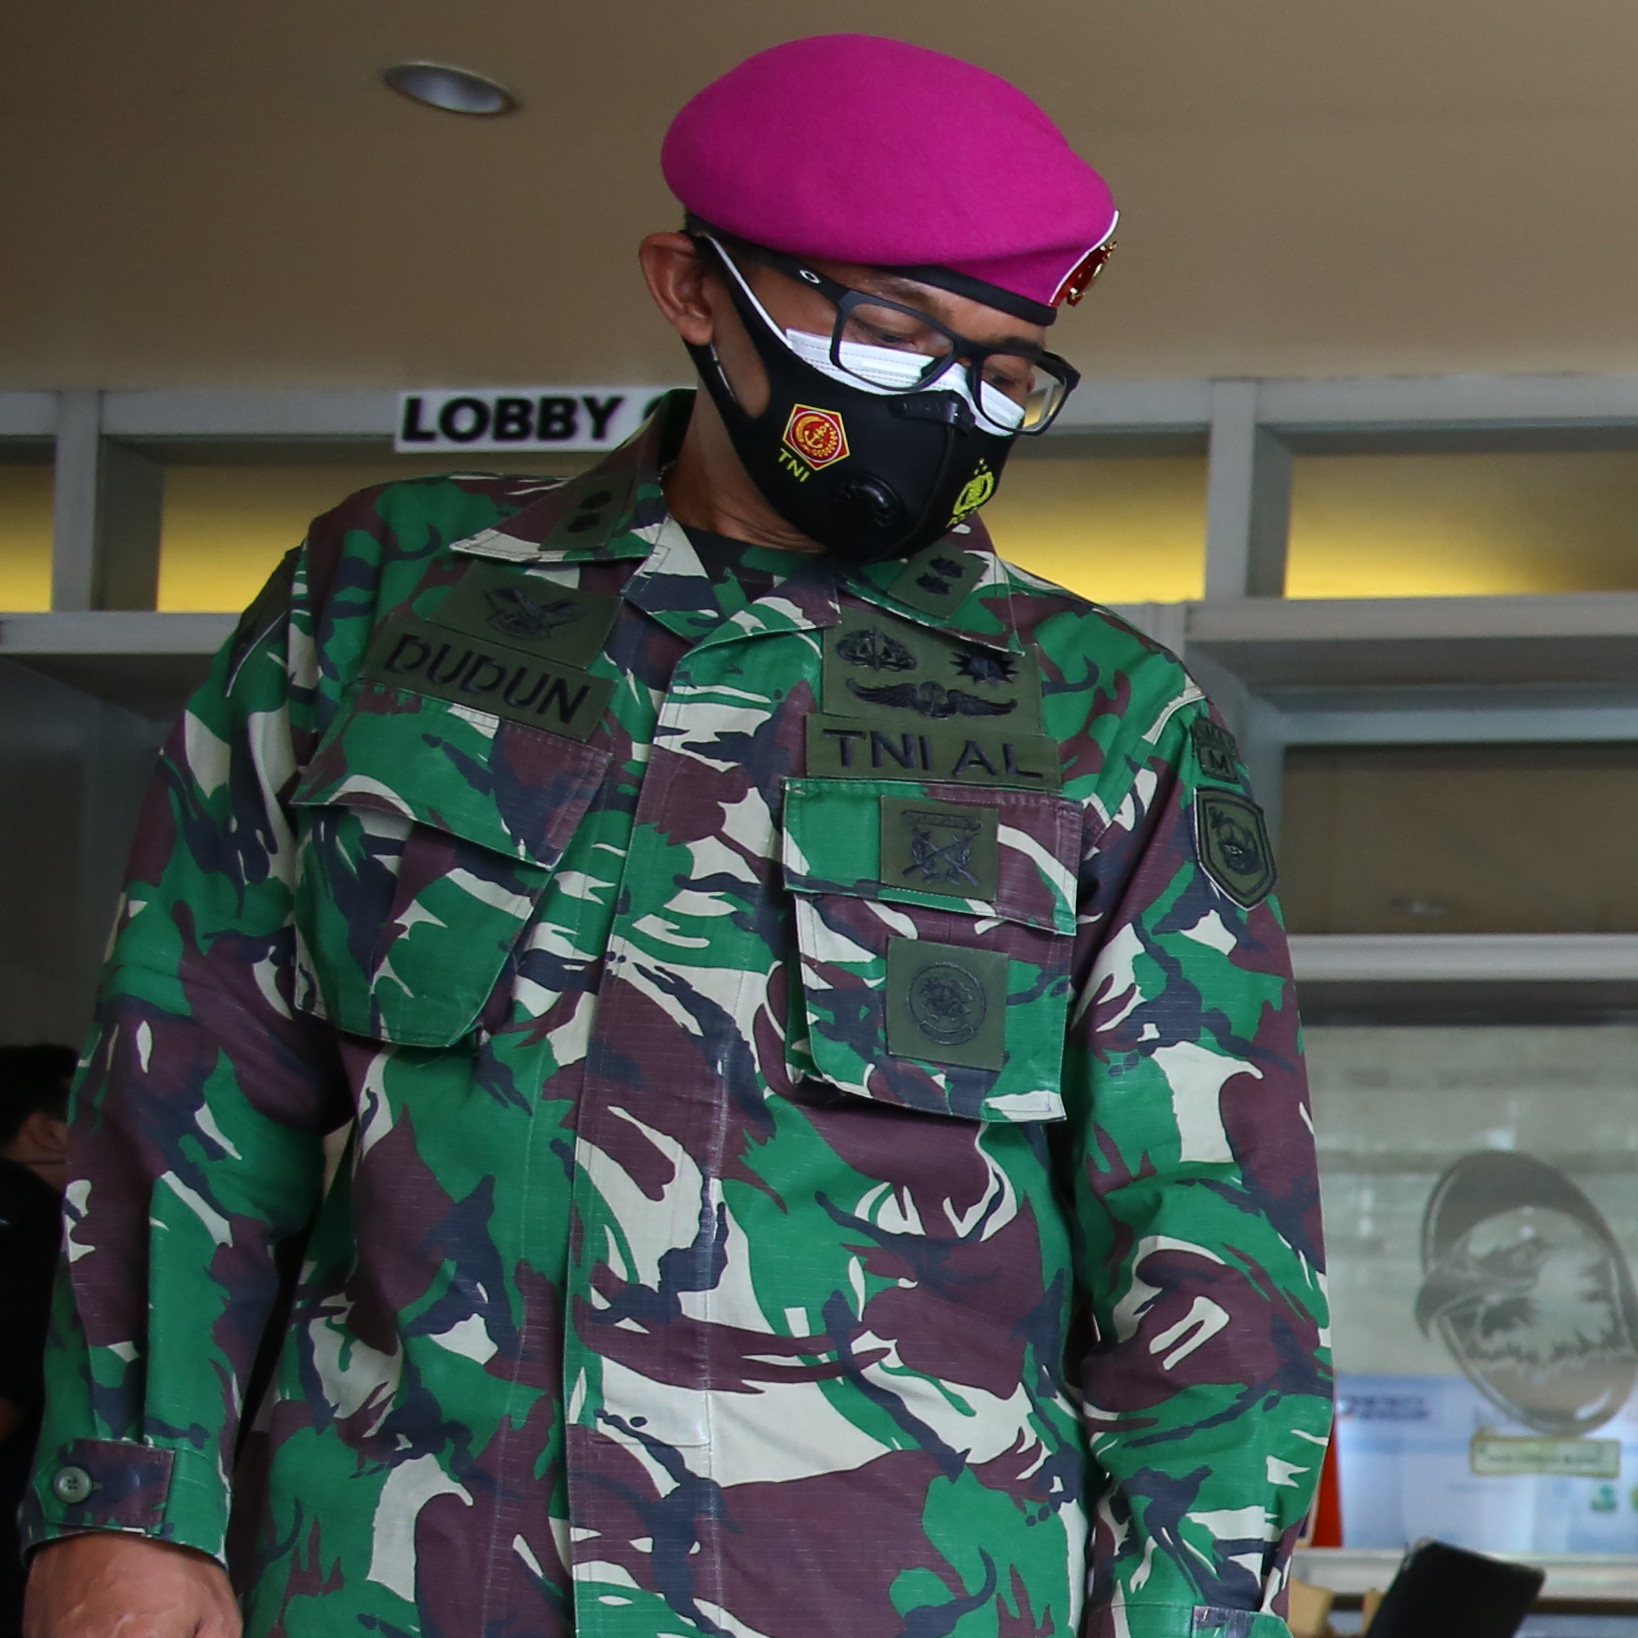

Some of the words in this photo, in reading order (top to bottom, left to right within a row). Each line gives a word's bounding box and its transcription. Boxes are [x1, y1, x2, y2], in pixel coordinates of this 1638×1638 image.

[401, 395, 626, 442] LOBBY
[778, 448, 810, 483] TNI
[385, 633, 591, 725] DUDUN
[822, 728, 932, 771] TNI
[952, 739, 1044, 780] AL
